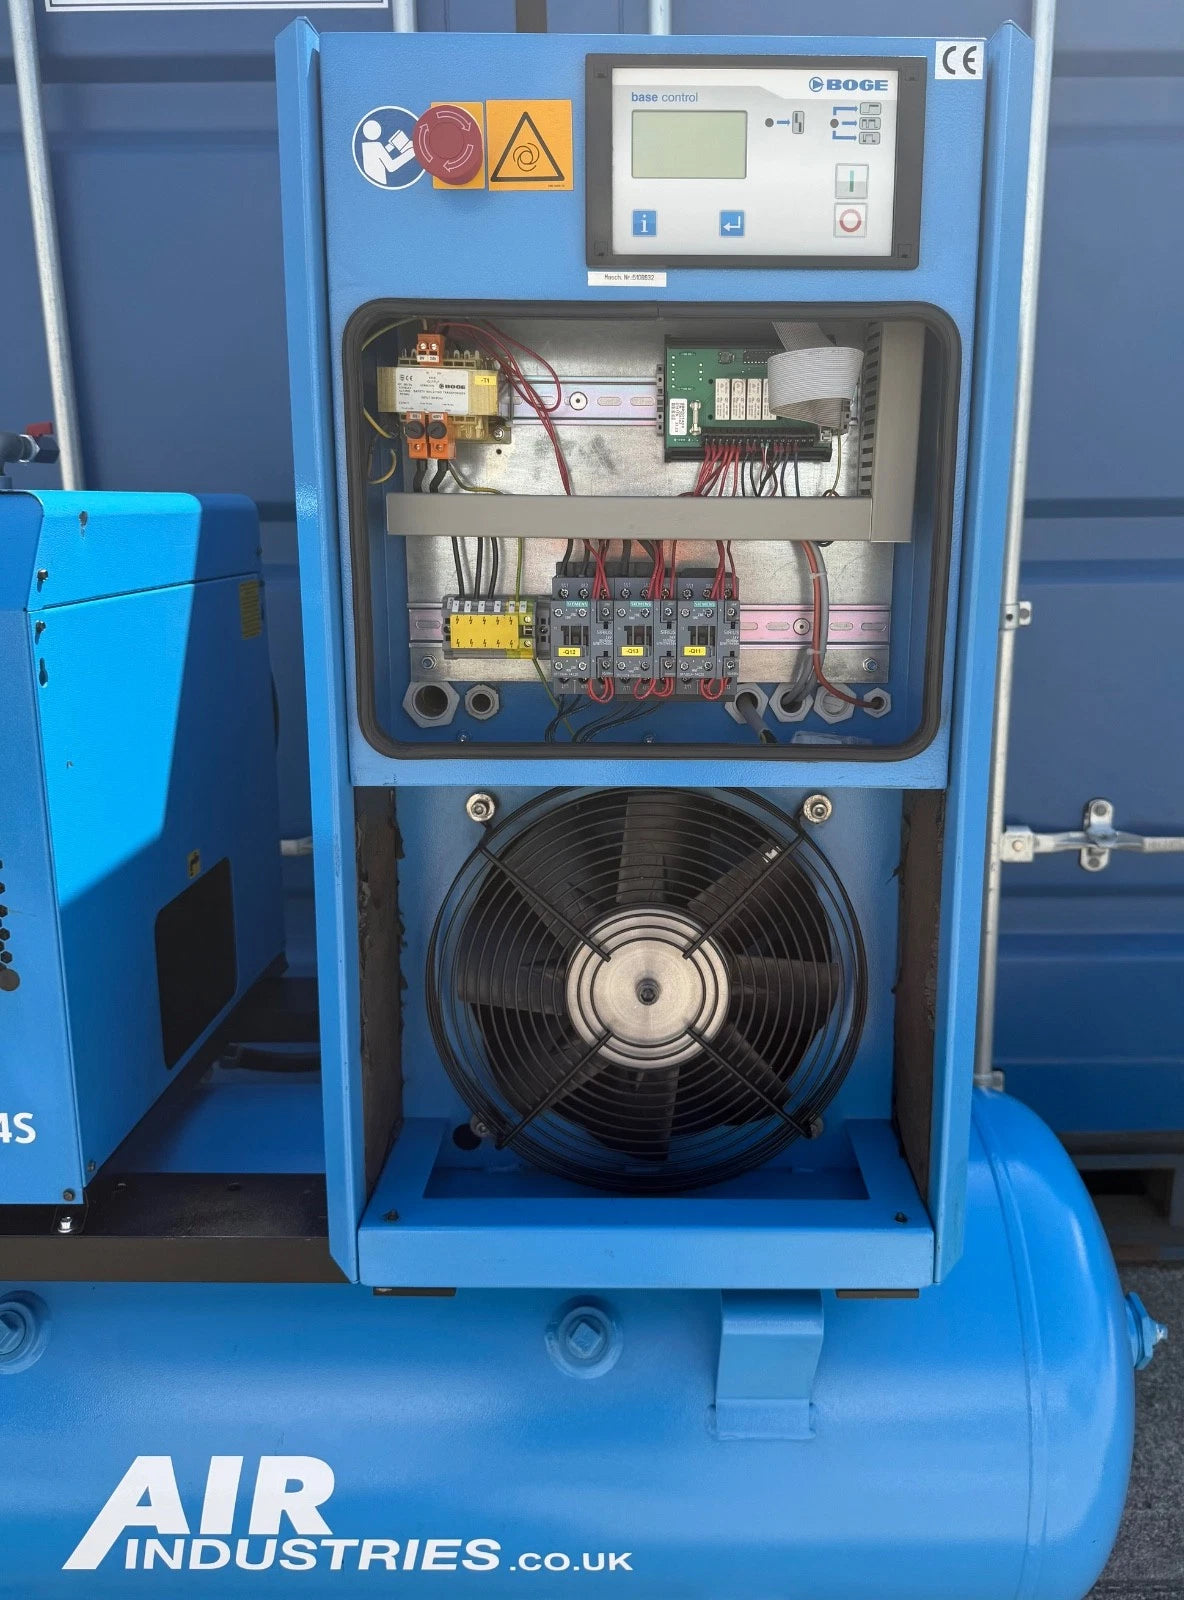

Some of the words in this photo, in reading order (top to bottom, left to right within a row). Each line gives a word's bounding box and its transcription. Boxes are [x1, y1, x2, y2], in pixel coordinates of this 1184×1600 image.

[942, 45, 978, 75] CE
[631, 91, 658, 103] base
[661, 91, 699, 103] control
[826, 79, 889, 92] BOGE
[62, 1456, 335, 1570] AIR
[125, 1538, 502, 1571] INDUSTRIES
[509, 1552, 634, 1572] .CO.UK
